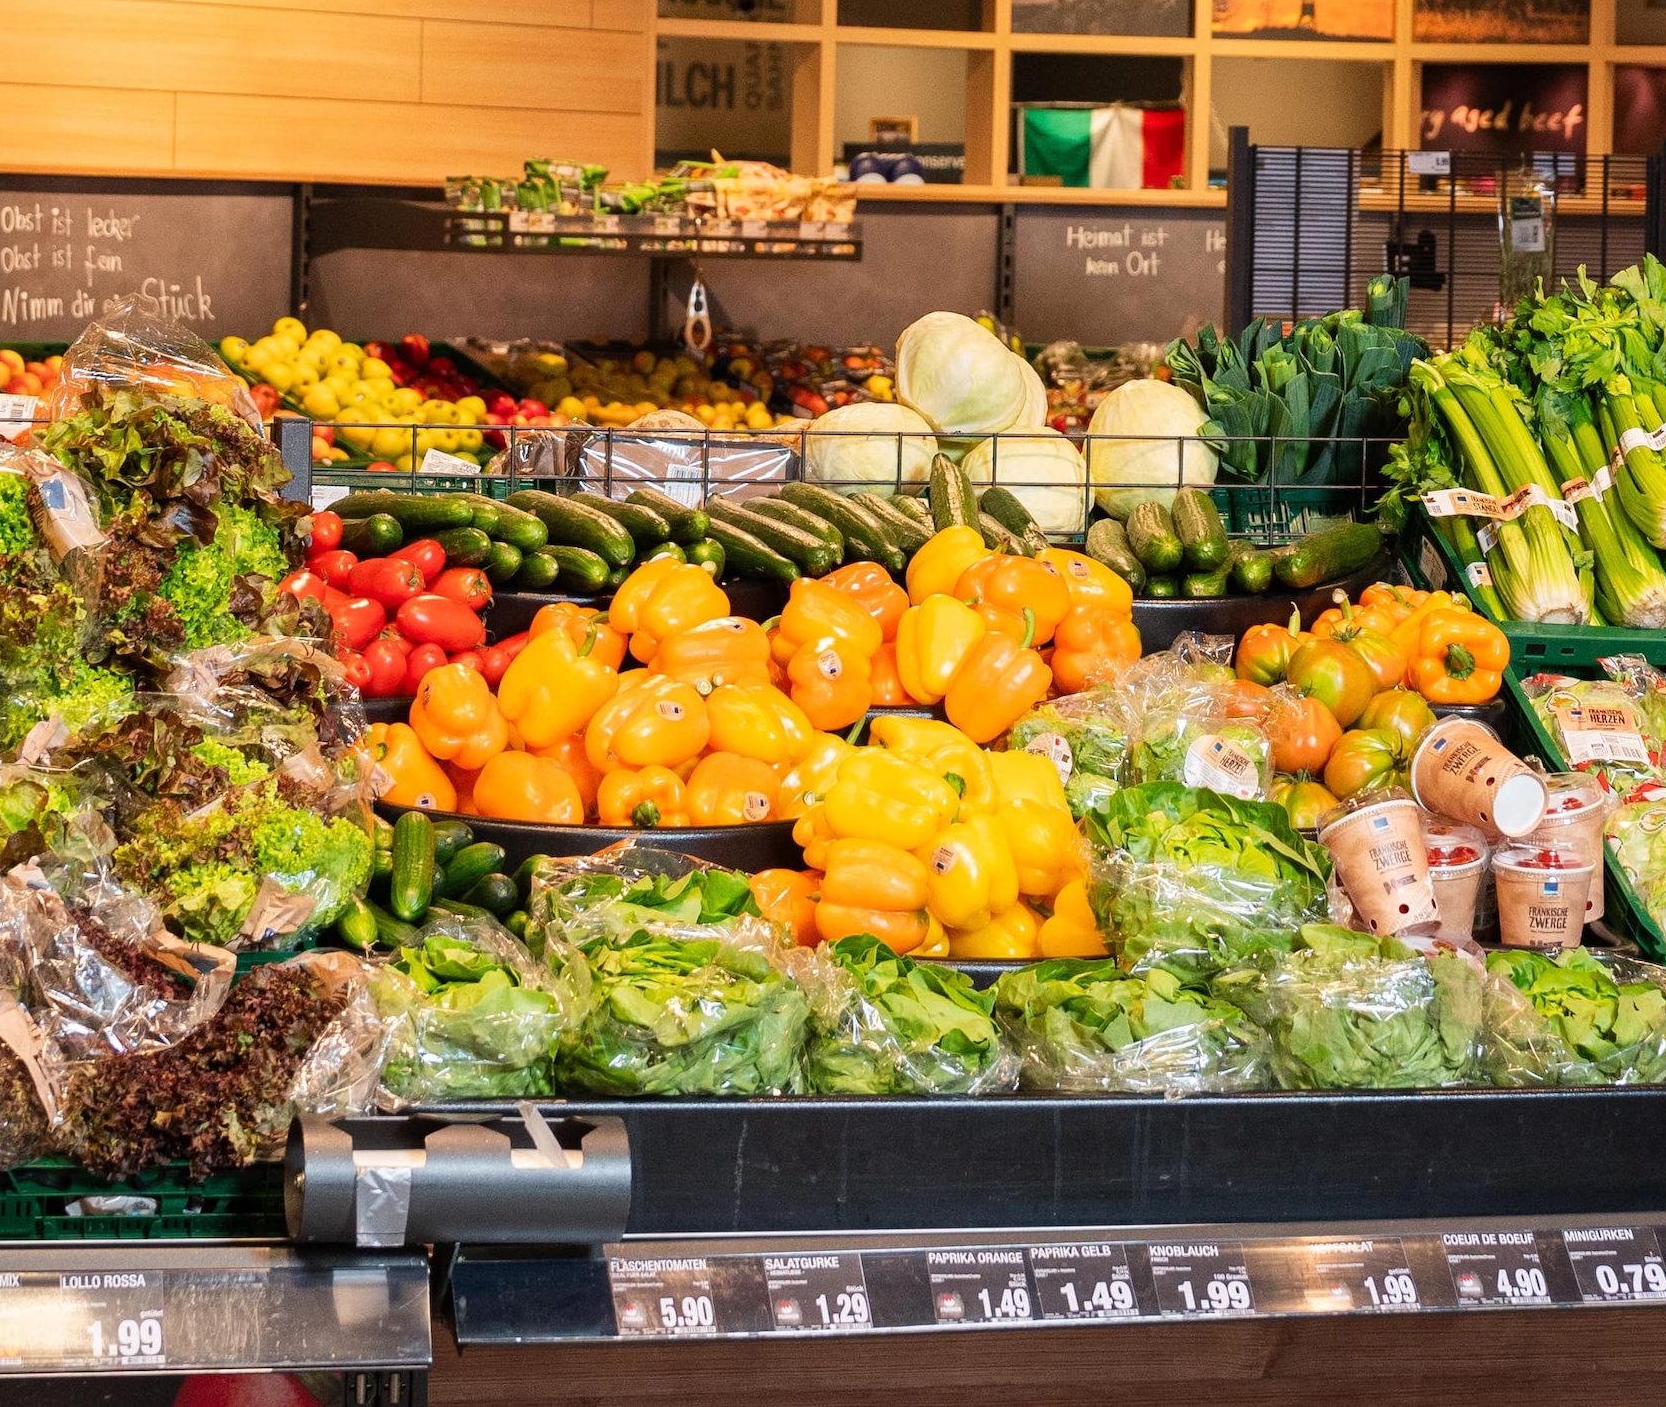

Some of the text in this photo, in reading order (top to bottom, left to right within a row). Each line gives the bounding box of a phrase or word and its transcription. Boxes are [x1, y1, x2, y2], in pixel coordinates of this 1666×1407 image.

[1450, 101, 1583, 140] aged beef
[0, 203, 141, 242] Obst ist lecker
[1066, 223, 1169, 250] Heimat ist
[0, 243, 123, 288] Obst ist fein
[1126, 251, 1163, 277] Ort
[1, 275, 215, 325] Nimm dir Stück
[1590, 713, 1626, 725] HERZEN
[1375, 851, 1412, 872] ZWERGE
[1529, 916, 1567, 929] ZWERGE
[1443, 1233, 1534, 1246] COEUR DE BOEUF
[1564, 1229, 1634, 1243] MINIGURKEN
[611, 1258, 707, 1271] FLASCHENTOMATEN
[765, 1256, 840, 1270] SALATGURKE
[928, 1251, 1023, 1265] PAPRIKA ORANGE
[1031, 1245, 1111, 1259] PAPRIKA GELB
[1149, 1245, 1219, 1258] KNOBLAUCH
[62, 1274, 146, 1289] LOLLO ROSSA
[1365, 1274, 1417, 1305] 1.99
[1496, 1268, 1547, 1298] 4.90
[1595, 1263, 1666, 1293] 0.79
[816, 1293, 868, 1325] 1.29
[978, 1288, 1030, 1318] 1.49
[1060, 1280, 1133, 1312] 1.49
[1178, 1280, 1250, 1310] 1.99
[660, 1296, 713, 1327] 5.90
[88, 1319, 162, 1356] 1.99
